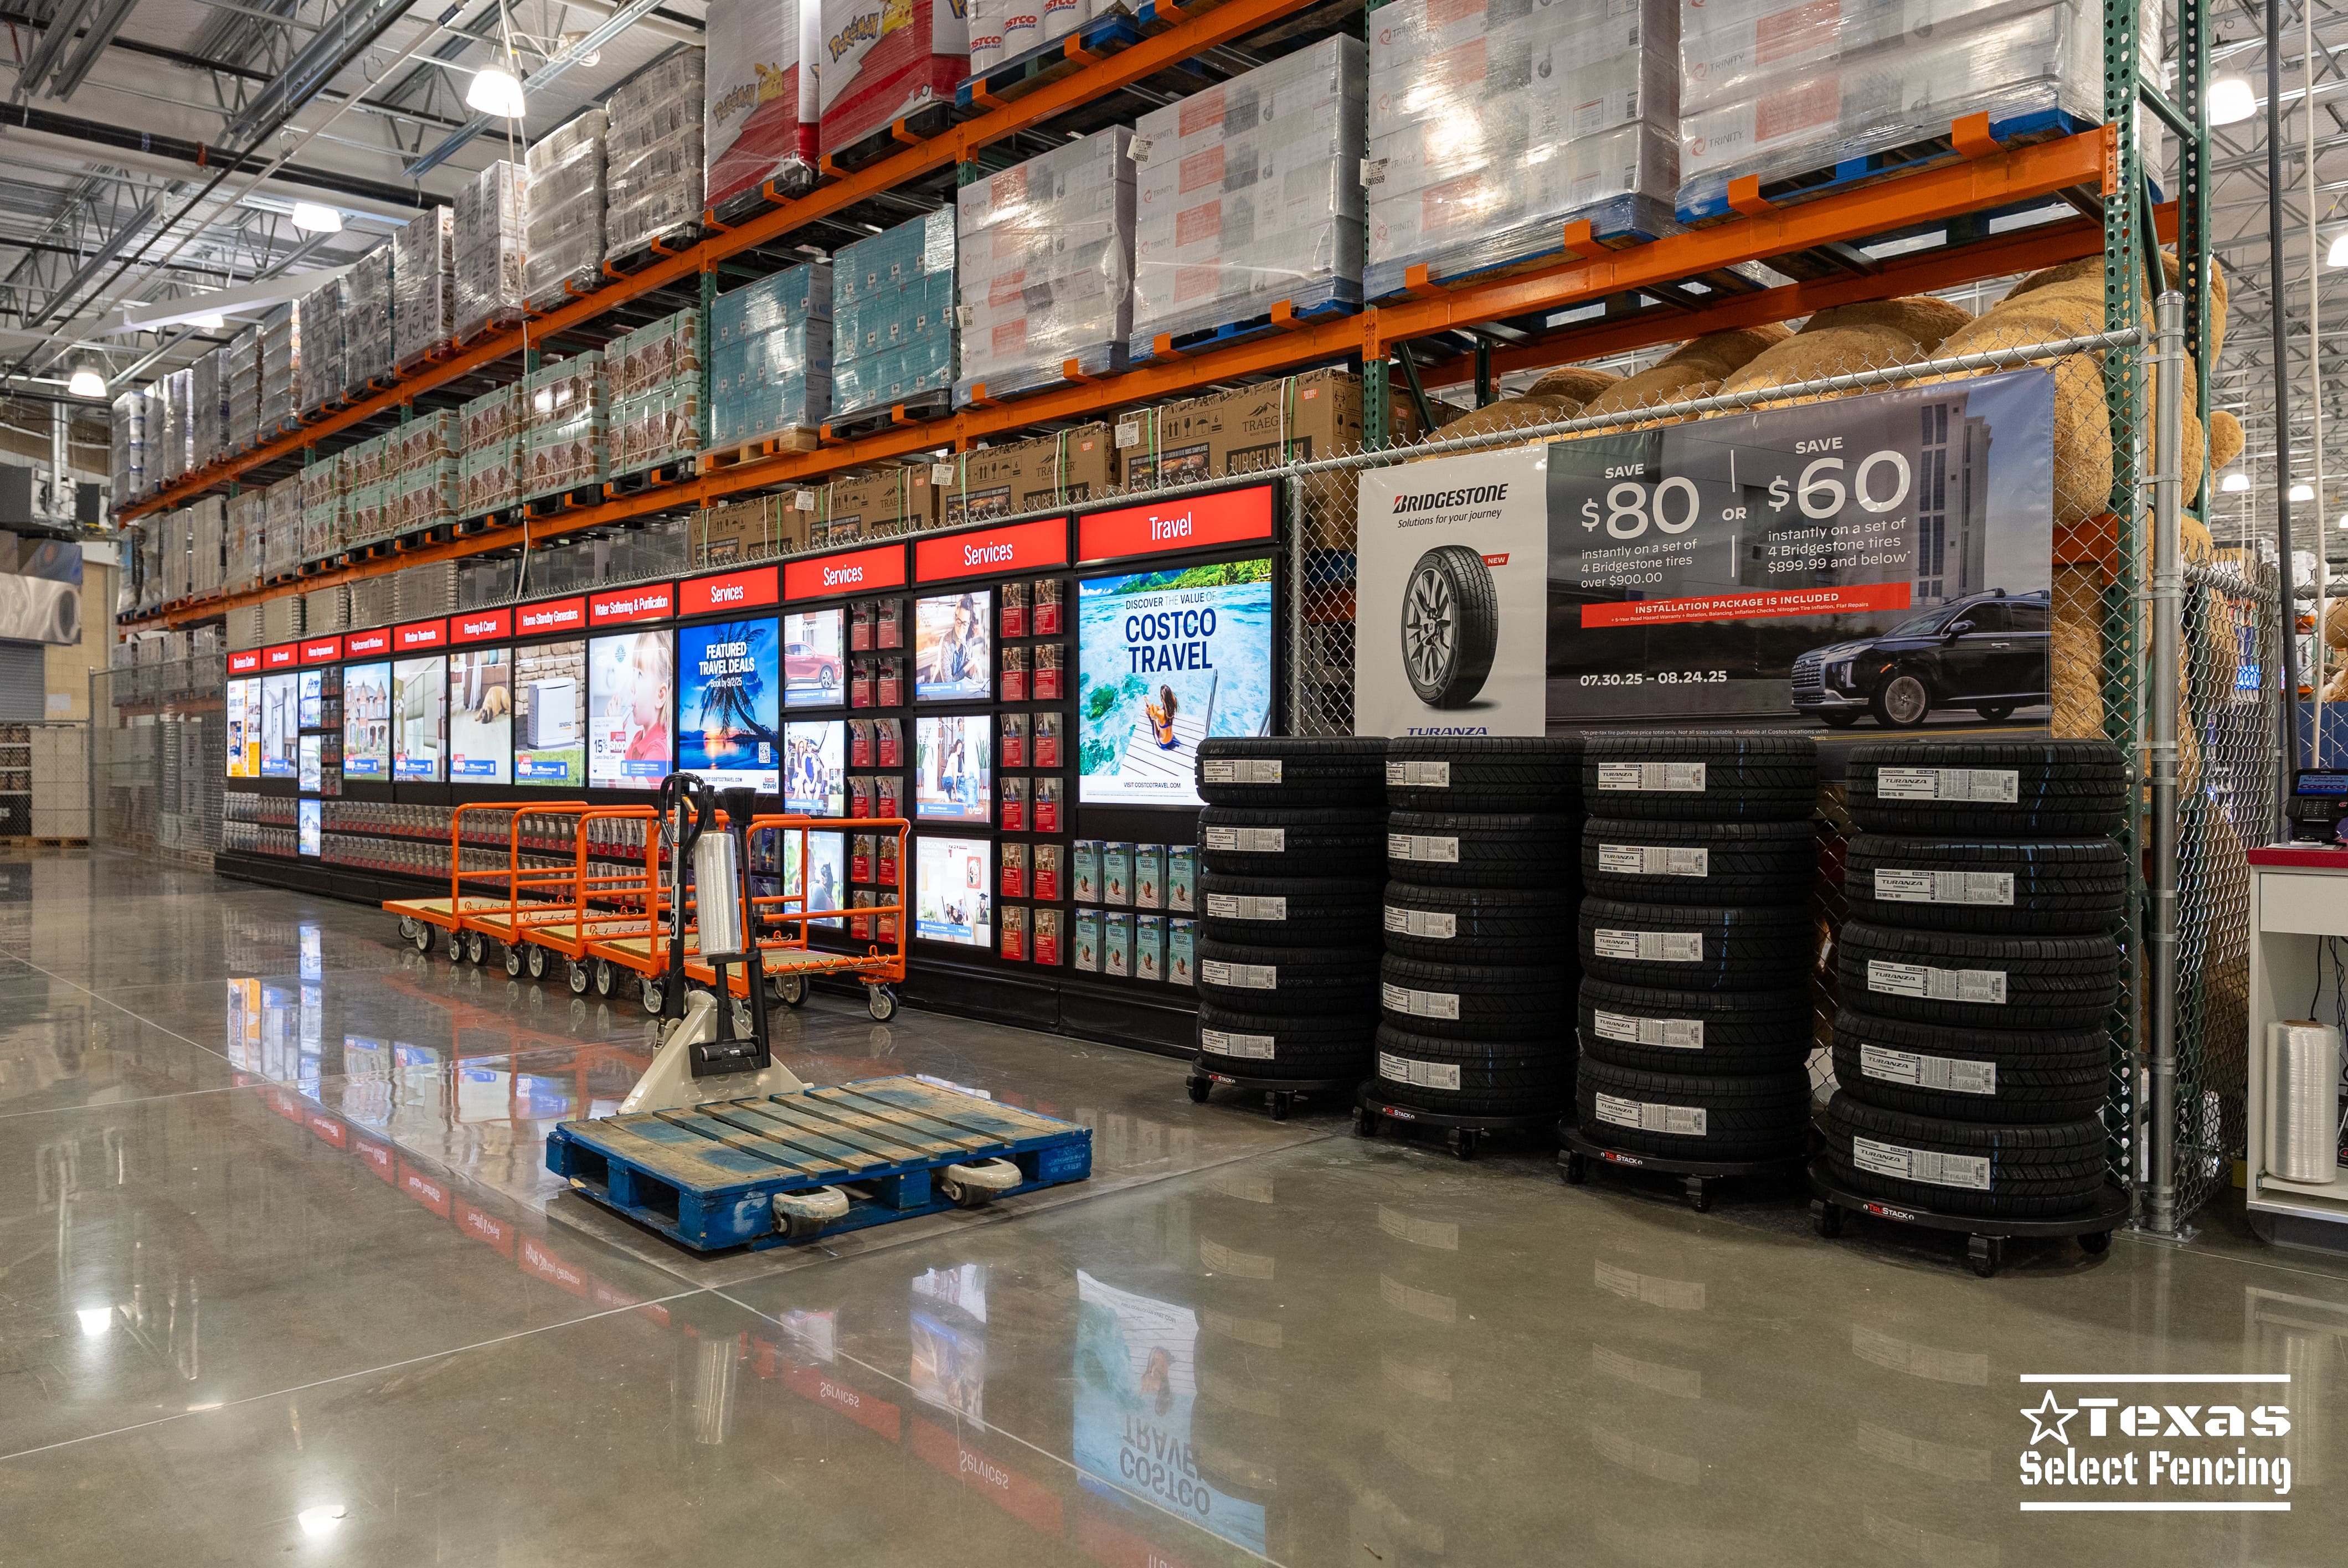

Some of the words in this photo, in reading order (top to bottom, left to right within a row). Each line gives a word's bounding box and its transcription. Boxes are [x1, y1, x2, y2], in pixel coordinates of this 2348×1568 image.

[1710, 53, 1744, 73] TRINITY
[1154, 128, 1174, 141] TRINITY
[1709, 131, 1743, 148] TRINITY
[1365, 175, 1385, 185] 1900509
[1154, 185, 1174, 197] TRINITY
[1795, 437, 1844, 454] SAVE
[1605, 463, 1644, 479] SAVE
[1768, 450, 1911, 519] $60
[1392, 483, 1508, 514] BRIDGESTONE
[1581, 476, 1700, 540] $80
[1722, 507, 1747, 522] OR
[1149, 511, 1192, 541] Travel
[1398, 516, 1433, 528] Solutions
[1435, 514, 1447, 524] for
[1449, 513, 1468, 524] your
[1468, 509, 1502, 522] journey
[1768, 526, 1827, 541] instantly
[1831, 525, 1848, 535] on
[1852, 525, 1860, 534] a
[1865, 520, 1887, 533] set
[1891, 517, 1906, 530] of
[964, 541, 1013, 566] Services
[1582, 546, 1631, 559] instantly
[1634, 546, 1649, 554] on
[1652, 545, 1659, 553] a
[1662, 541, 1681, 552] set
[1684, 539, 1697, 550] of
[1768, 546, 1777, 557] 4
[1781, 540, 1864, 556] Bridgestone
[1868, 537, 1901, 548] tires
[1582, 564, 1589, 573] 4
[1593, 559, 1662, 573] Bridgestone
[1666, 556, 1692, 566] tires
[1768, 558, 1826, 574] $899.99
[1831, 555, 1856, 568] and
[823, 564, 863, 587] Services
[1582, 579, 1606, 588] over
[1609, 572, 1662, 587] $900.00
[711, 584, 744, 603] Services
[1126, 597, 1163, 610] DISCOVER
[1165, 595, 1178, 606] THE
[1181, 592, 1204, 604] VALUE
[1206, 591, 1217, 601] OF
[595, 604, 609, 616] Water
[610, 601, 634, 615] Softening
[634, 599, 639, 611] &
[639, 595, 668, 610] Purification
[1636, 601, 1709, 613] INSTALLATION
[1713, 597, 1763, 608] PACKAGE
[1767, 597, 1777, 605] IS
[1780, 593, 1839, 604] INCLUDED
[523, 614, 535, 626] Home
[536, 612, 553, 625] Standby
[554, 610, 578, 622] Generators
[1126, 608, 1216, 642] COSTCO
[464, 623, 480, 636] Flooring
[483, 620, 496, 633] Carpet
[706, 642, 746, 659] FEATURED
[1129, 641, 1212, 673] TRAVEL
[699, 660, 728, 675] TRAVEL
[728, 657, 755, 673] DEALS
[710, 679, 721, 688] Book
[721, 679, 727, 688] by
[727, 677, 742, 687] 9/2/25
[1580, 673, 1643, 687] 07.30.25
[1657, 670, 1727, 684] 08.24.25
[1407, 727, 1489, 736] TURANZA
[610, 740, 626, 753] shop
[453, 760, 466, 773] shop
[518, 762, 532, 776] shop
[1875, 972, 1916, 981] TURANZA
[1599, 1019, 1630, 1029] TURANZA
[1868, 1057, 1908, 1068] TURANZA
[1601, 1103, 1633, 1113] TURANZA
[1861, 1149, 1900, 1162] TURANZA
